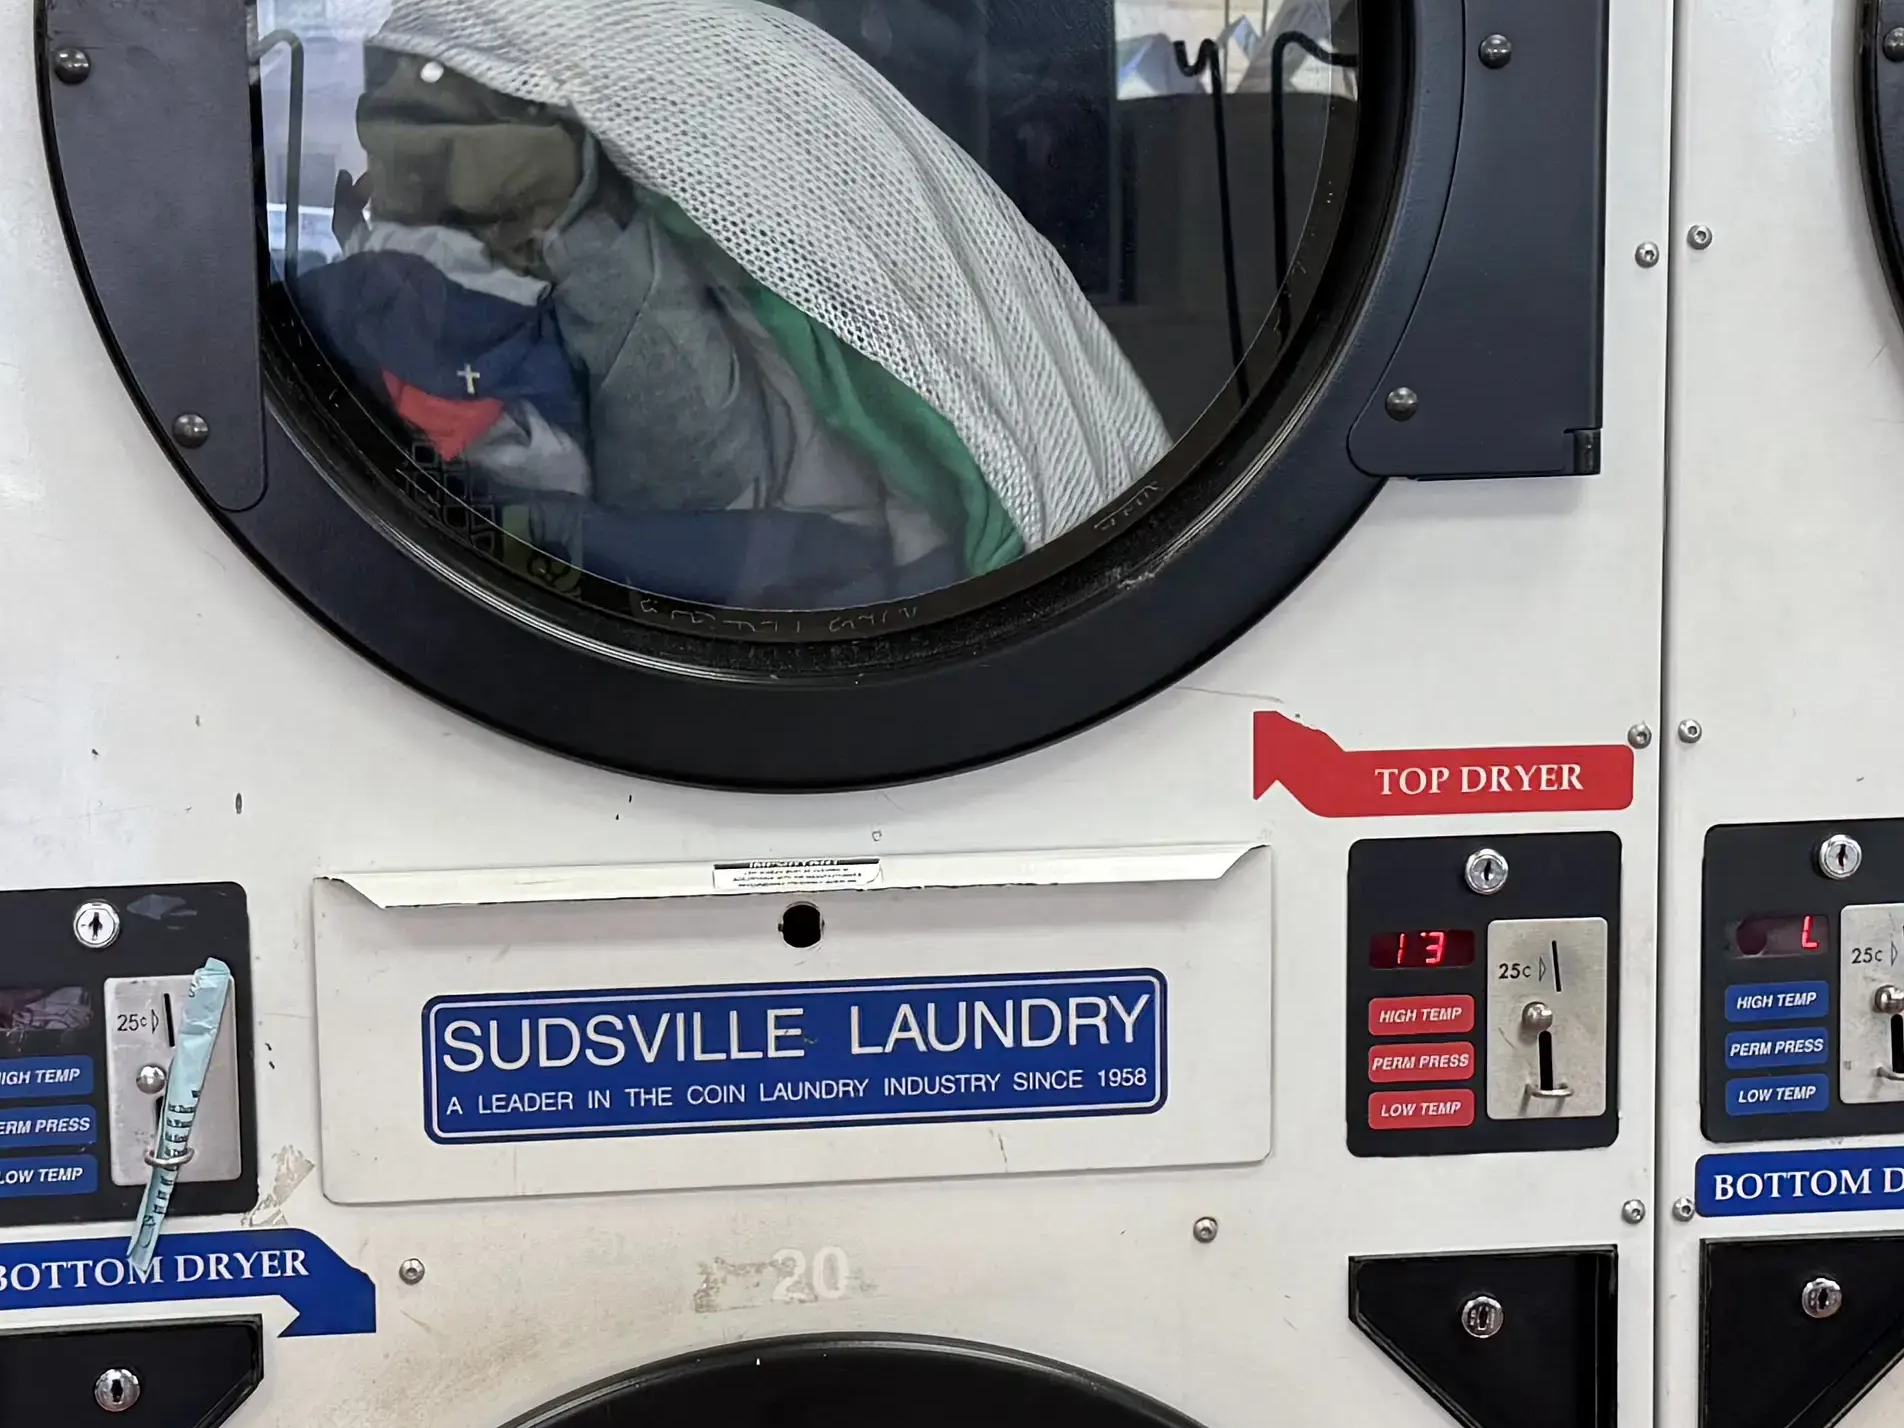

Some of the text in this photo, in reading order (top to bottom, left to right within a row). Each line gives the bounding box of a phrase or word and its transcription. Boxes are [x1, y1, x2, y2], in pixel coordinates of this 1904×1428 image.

[1374, 763, 1584, 795] TOP DRYER
[1498, 962, 1532, 980] 25c
[1736, 991, 1817, 1010] HIGH TEMP
[1379, 1007, 1463, 1023] HIGH TEMP
[442, 993, 1151, 1073] SUDSVILLE LAUNDRY
[1729, 1038, 1824, 1057] PERM PRESS
[1371, 1053, 1469, 1071] PERM PRESS
[35, 1068, 81, 1084] TEMP
[446, 1067, 1147, 1116] A LEADER IN THE COIN LAUNDRY INDUSTRY SINCE 1958
[1738, 1085, 1817, 1103] LOW TEMP
[1381, 1101, 1462, 1117] LOW TEMP
[34, 1117, 91, 1133] PRESS
[37, 1167, 83, 1182] TEMP
[1713, 1167, 1873, 1201] BOTTOM
[176, 1249, 309, 1282] DRYER
[771, 1246, 849, 1303] 20
